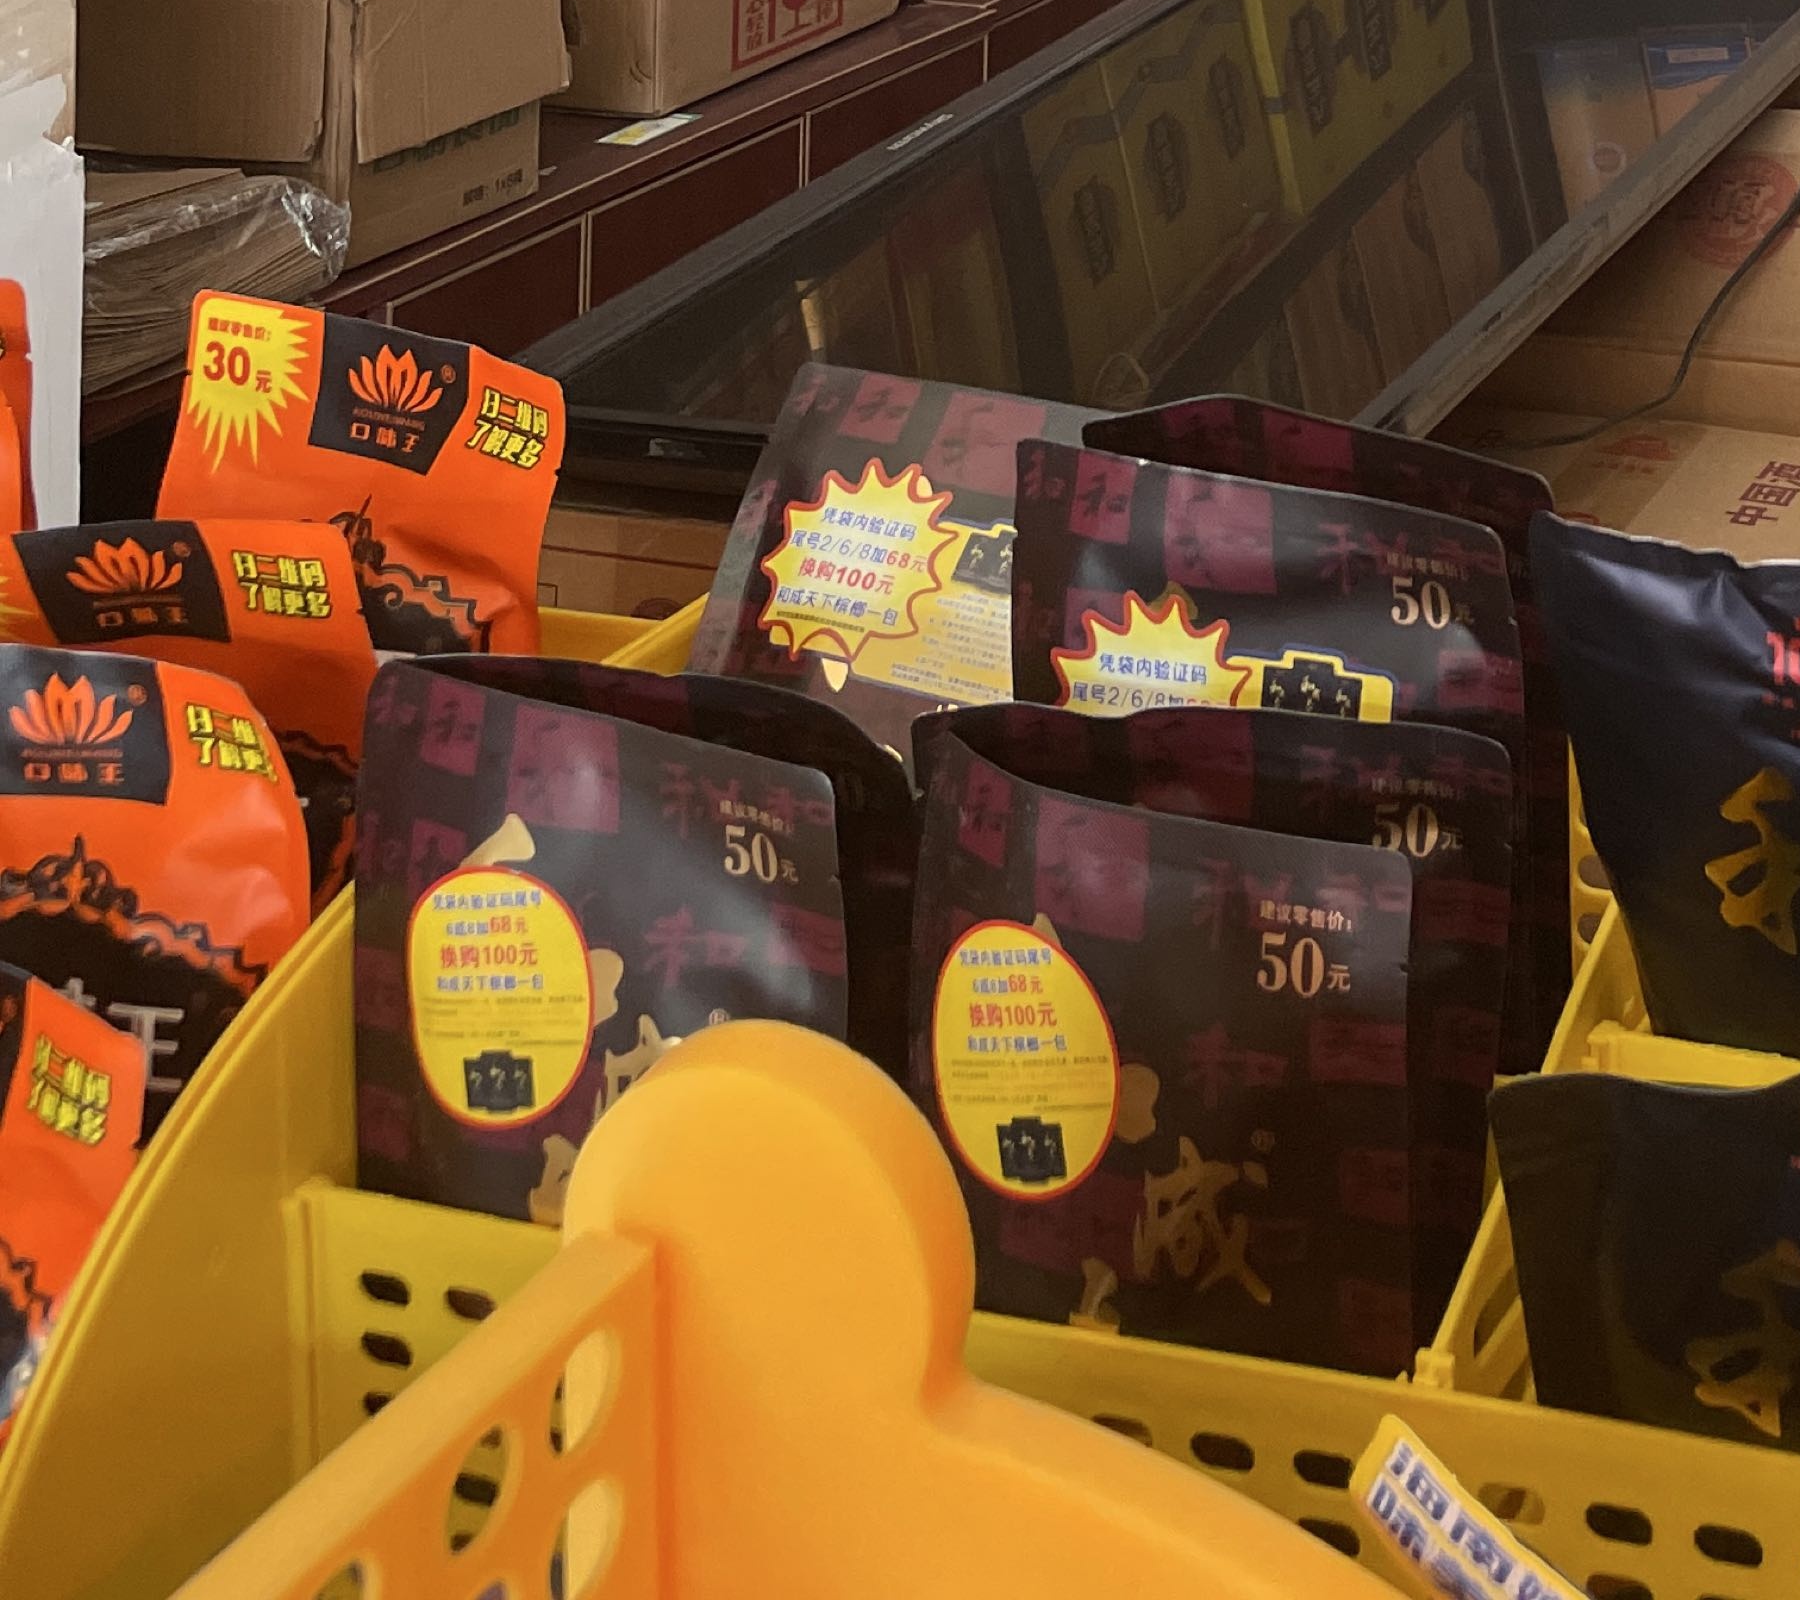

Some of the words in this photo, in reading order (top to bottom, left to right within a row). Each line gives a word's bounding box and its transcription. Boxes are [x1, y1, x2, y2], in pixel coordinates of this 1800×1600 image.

[203, 340, 273, 394] 30元
[350, 422, 421, 455] 口味王
[466, 419, 545, 469] 了解更多
[822, 507, 918, 542] 凭袋内验证码
[797, 557, 896, 595] 换购100元
[776, 585, 899, 626] 和成天下槟榔一包
[1099, 651, 1208, 687] 凭袋内验证码
[722, 824, 800, 885] 50元
[439, 942, 538, 969] 换购100元
[1256, 931, 1351, 1000] 50元
[969, 1001, 1058, 1029] 换购100元
